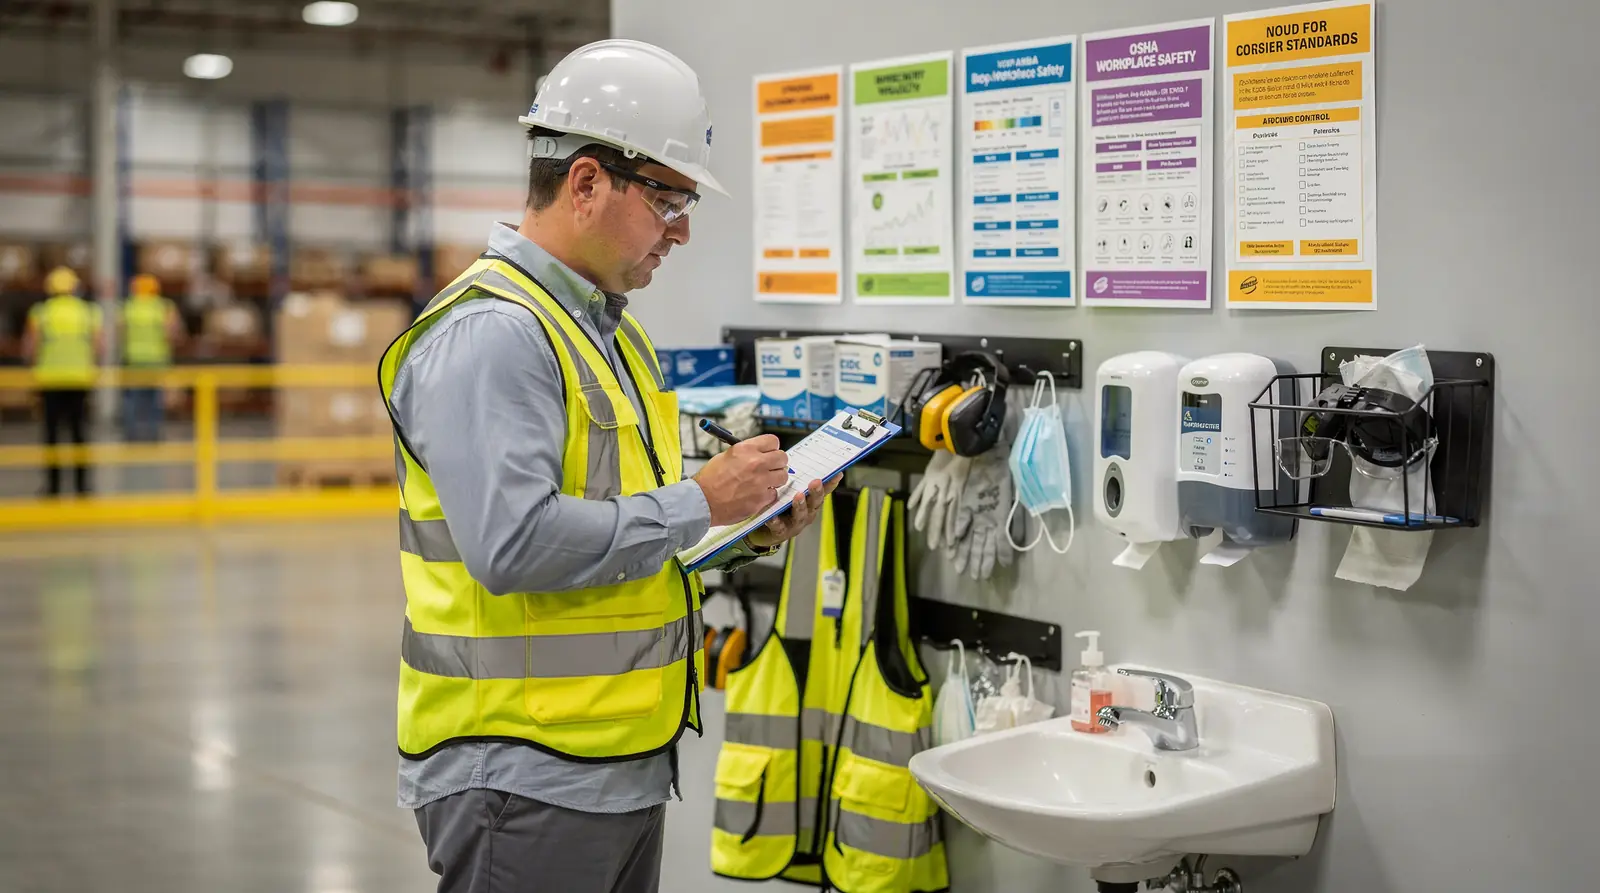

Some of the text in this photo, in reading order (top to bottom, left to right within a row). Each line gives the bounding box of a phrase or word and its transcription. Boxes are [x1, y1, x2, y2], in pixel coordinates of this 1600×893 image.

[1266, 20, 1327, 38] NOUD FOR
[1129, 40, 1158, 56] OSHA
[1236, 32, 1358, 57] CORSIER STANDARDS
[1096, 50, 1197, 73] WORKPLACE SAFETY
[1295, 113, 1330, 123] CONTROL
